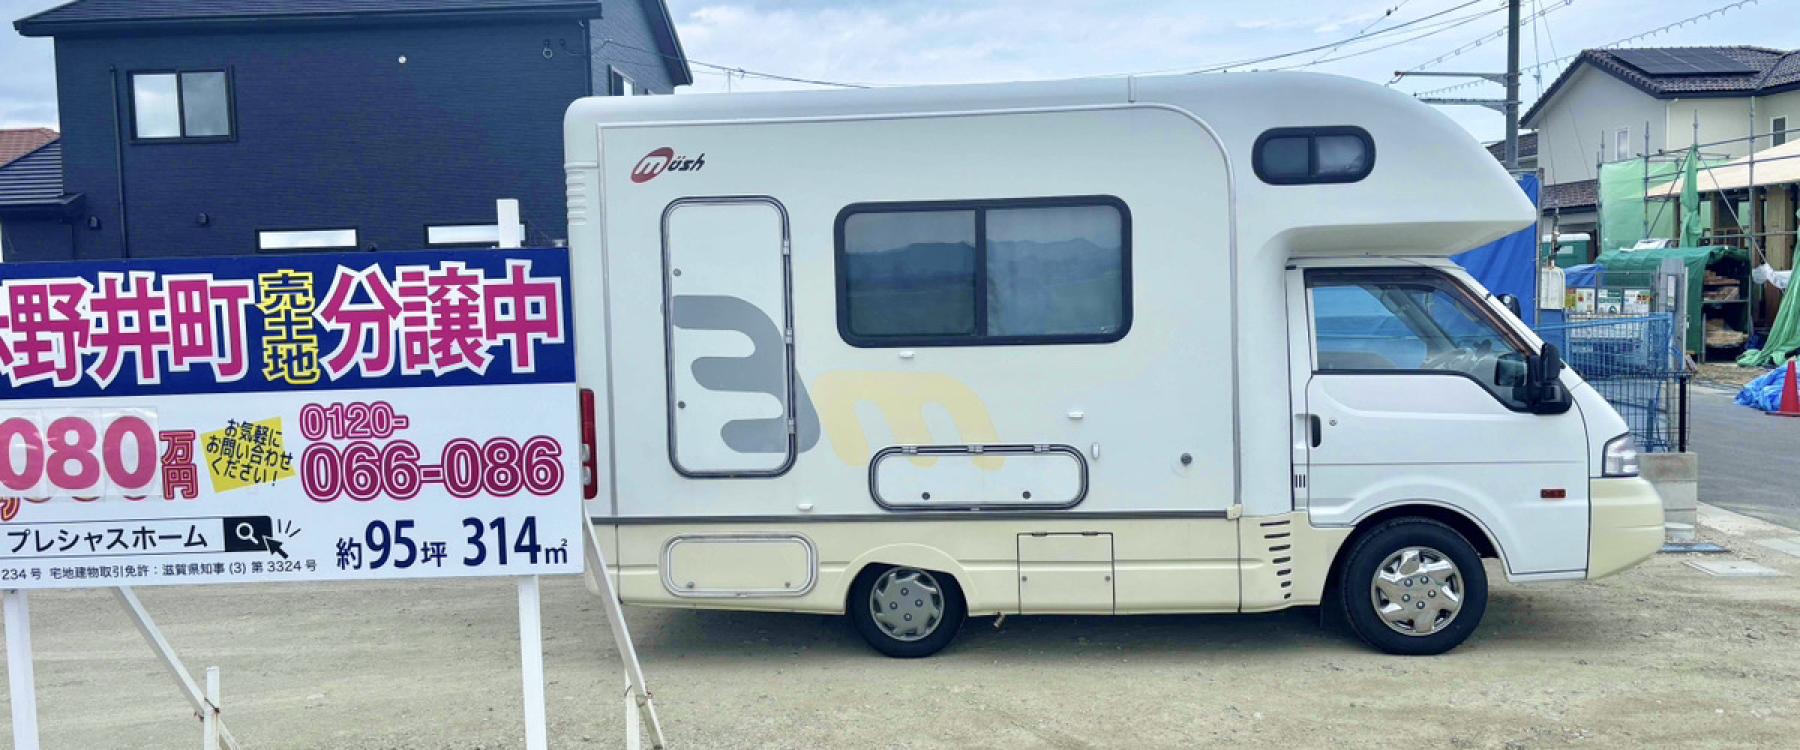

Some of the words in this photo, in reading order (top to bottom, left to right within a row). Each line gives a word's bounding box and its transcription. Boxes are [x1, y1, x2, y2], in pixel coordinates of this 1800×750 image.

[0, 271, 255, 390] 野井町
[256, 269, 320, 384] 売土地
[315, 259, 564, 380] 分譲中
[206, 435, 293, 470] お問い合わせ
[225, 418, 282, 447] お気軽に
[300, 401, 409, 441] 0120-
[159, 430, 199, 500] 万円
[301, 435, 564, 502] 066-086
[7, 525, 208, 553] プレシャスホーム
